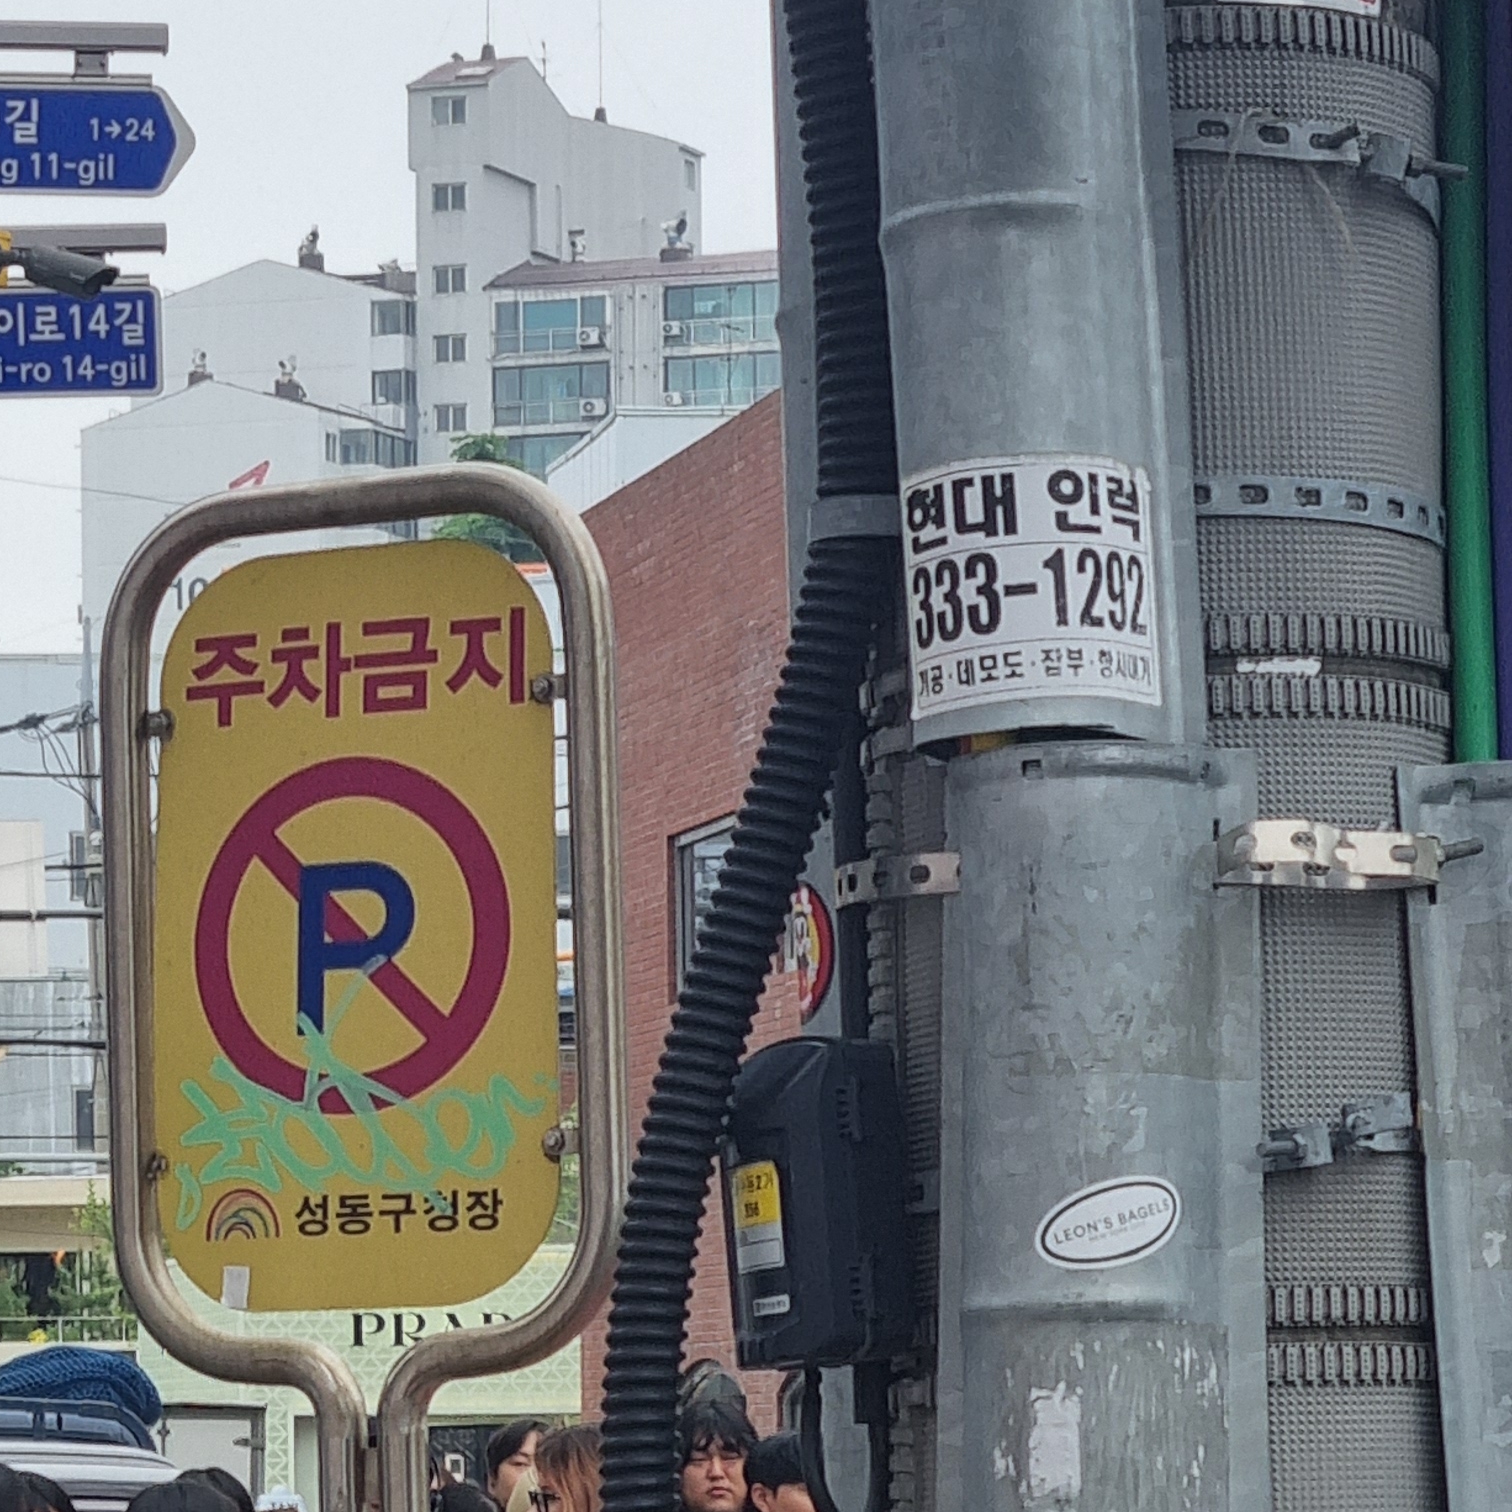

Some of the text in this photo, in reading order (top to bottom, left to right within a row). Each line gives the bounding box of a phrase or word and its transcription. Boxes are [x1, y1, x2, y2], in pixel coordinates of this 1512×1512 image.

[30, 152, 115, 184] 11-gil
[62, 353, 146, 389] 14-gil
[906, 468, 1141, 555] 현대 인력
[912, 546, 1147, 650] 333-1292
[186, 605, 526, 729] 주차금지
[294, 1188, 504, 1237] 성동구청장
[1052, 1215, 1115, 1245] LEON'S
[1117, 1197, 1171, 1226] BAGELS
